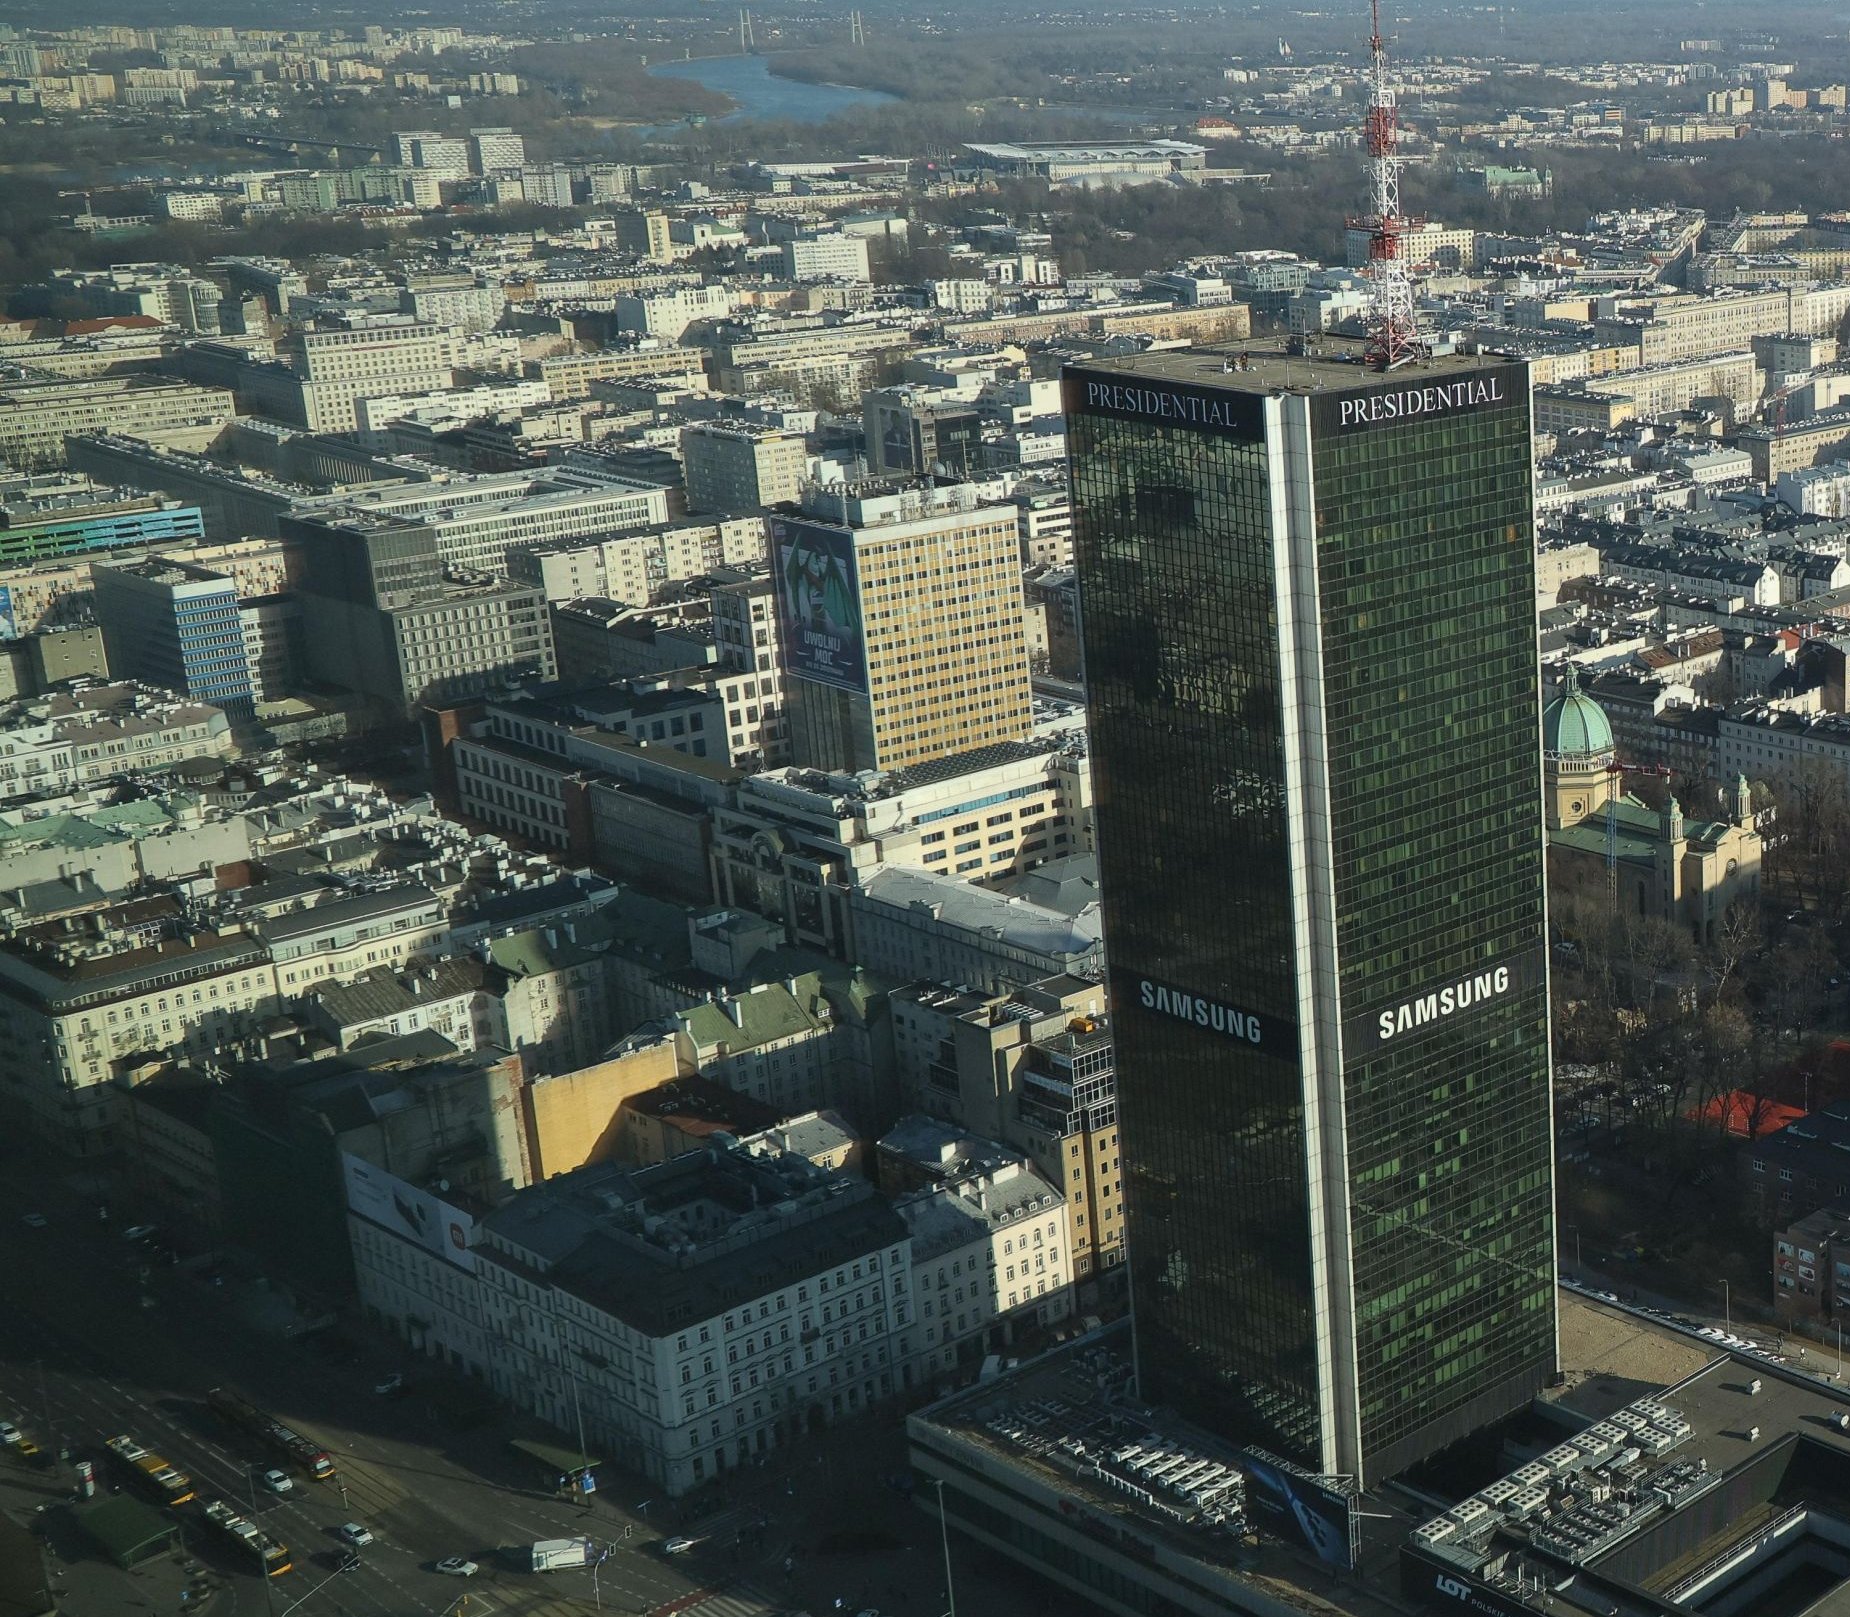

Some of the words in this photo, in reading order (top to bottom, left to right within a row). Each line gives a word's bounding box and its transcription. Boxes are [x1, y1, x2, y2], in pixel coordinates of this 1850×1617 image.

[1087, 381, 1238, 428] PRESIDENTIAL
[1339, 376, 1503, 427] PRESIDENTIAL
[814, 648, 833, 665] MOC
[1140, 979, 1261, 1043] SAMSUNG
[1379, 966, 1509, 1039] SAMSUNG
[1436, 1574, 1472, 1601] LOT
